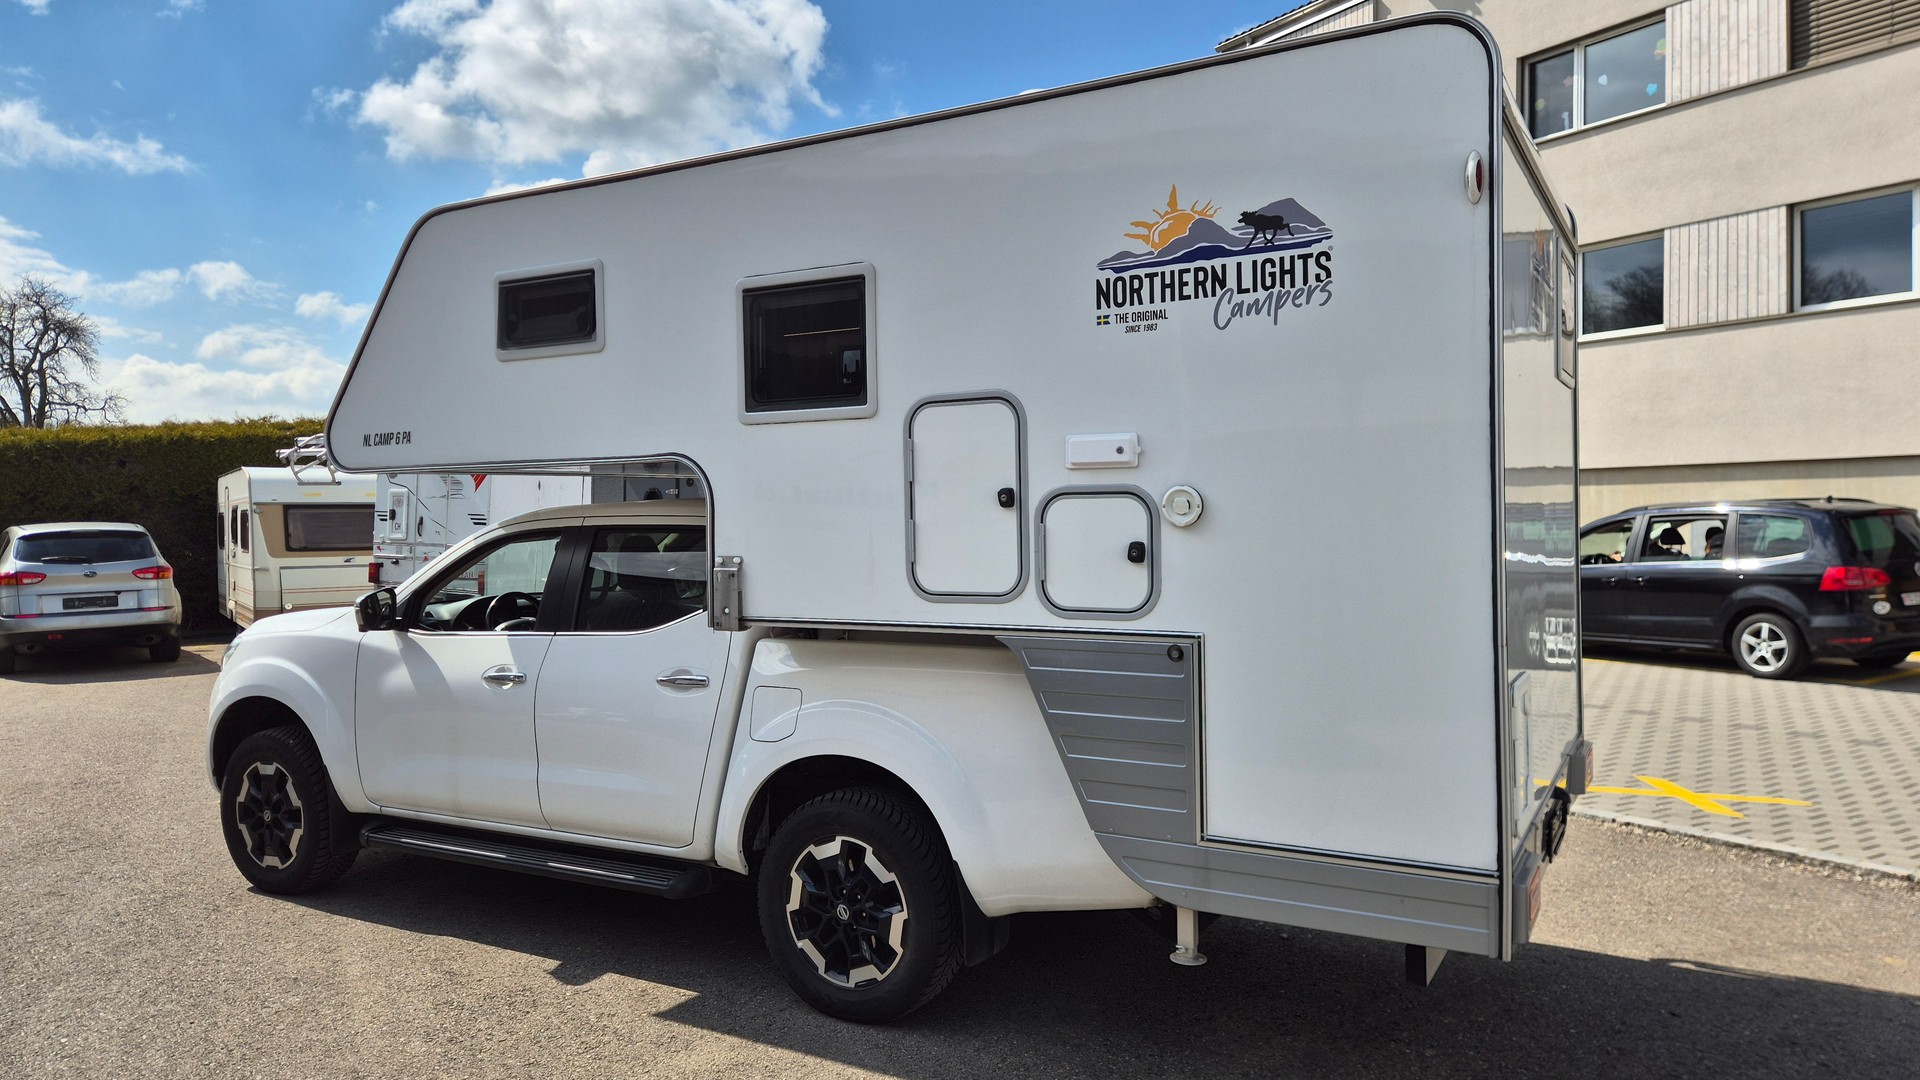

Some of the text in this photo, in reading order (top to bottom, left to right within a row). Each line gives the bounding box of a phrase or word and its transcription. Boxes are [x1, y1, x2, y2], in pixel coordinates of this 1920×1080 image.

[1096, 251, 1332, 310] NORTHERN LIGHTS
[1213, 280, 1333, 331] Campers
[1114, 309, 1168, 324] THE ORIGINAL
[1125, 323, 1158, 333] SINCE 1983
[362, 431, 411, 447] NL CAMP 6 PA
